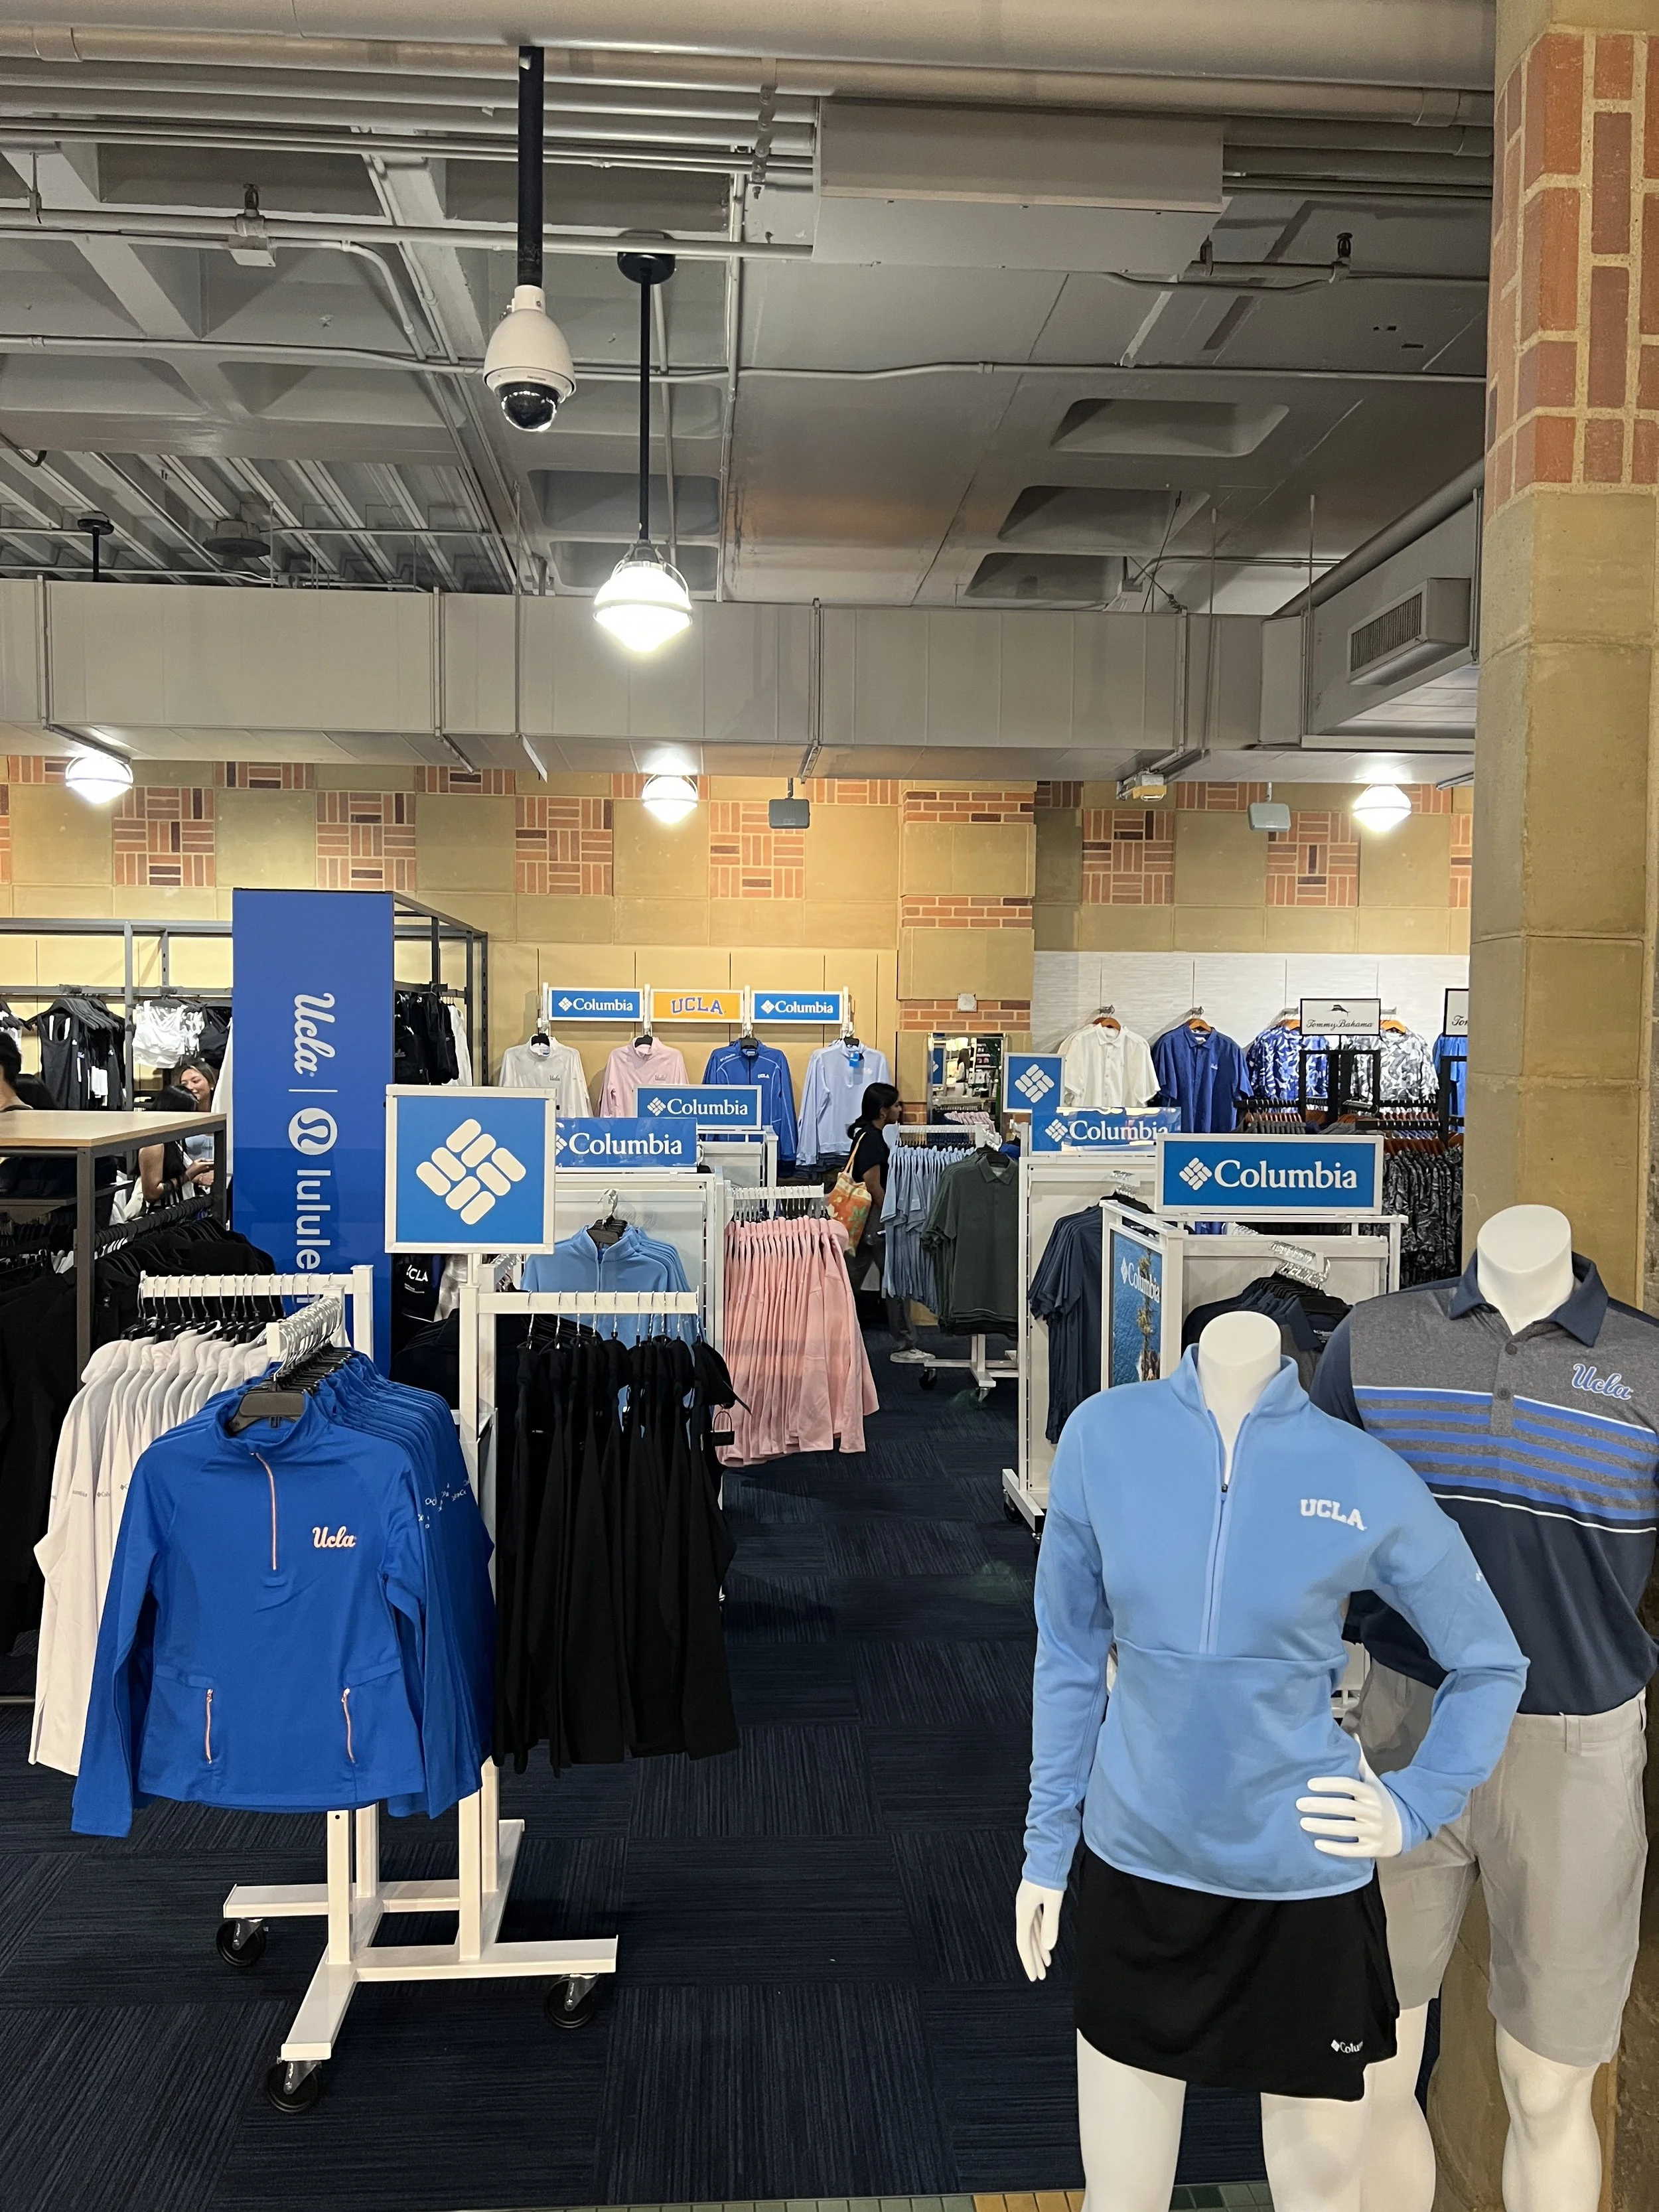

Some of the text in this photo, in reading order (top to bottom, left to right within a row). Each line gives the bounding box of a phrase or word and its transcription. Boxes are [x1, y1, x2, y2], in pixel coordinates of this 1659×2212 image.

[573, 997, 633, 1011] Columbia
[670, 996, 724, 1015] UCLA
[775, 1000, 834, 1014] Columbia
[294, 992, 336, 1075] Ucla
[1305, 1019, 1373, 1031] Tommy Bahama
[667, 1098, 748, 1115] Columbia
[569, 1132, 682, 1155] Columbia
[1214, 1159, 1358, 1189] Columbia
[1128, 1262, 1160, 1303] Columbia
[1571, 1363, 1632, 1400] Ucla
[1300, 1499, 1366, 1531] UCLA
[312, 1526, 356, 1548] Ucla
